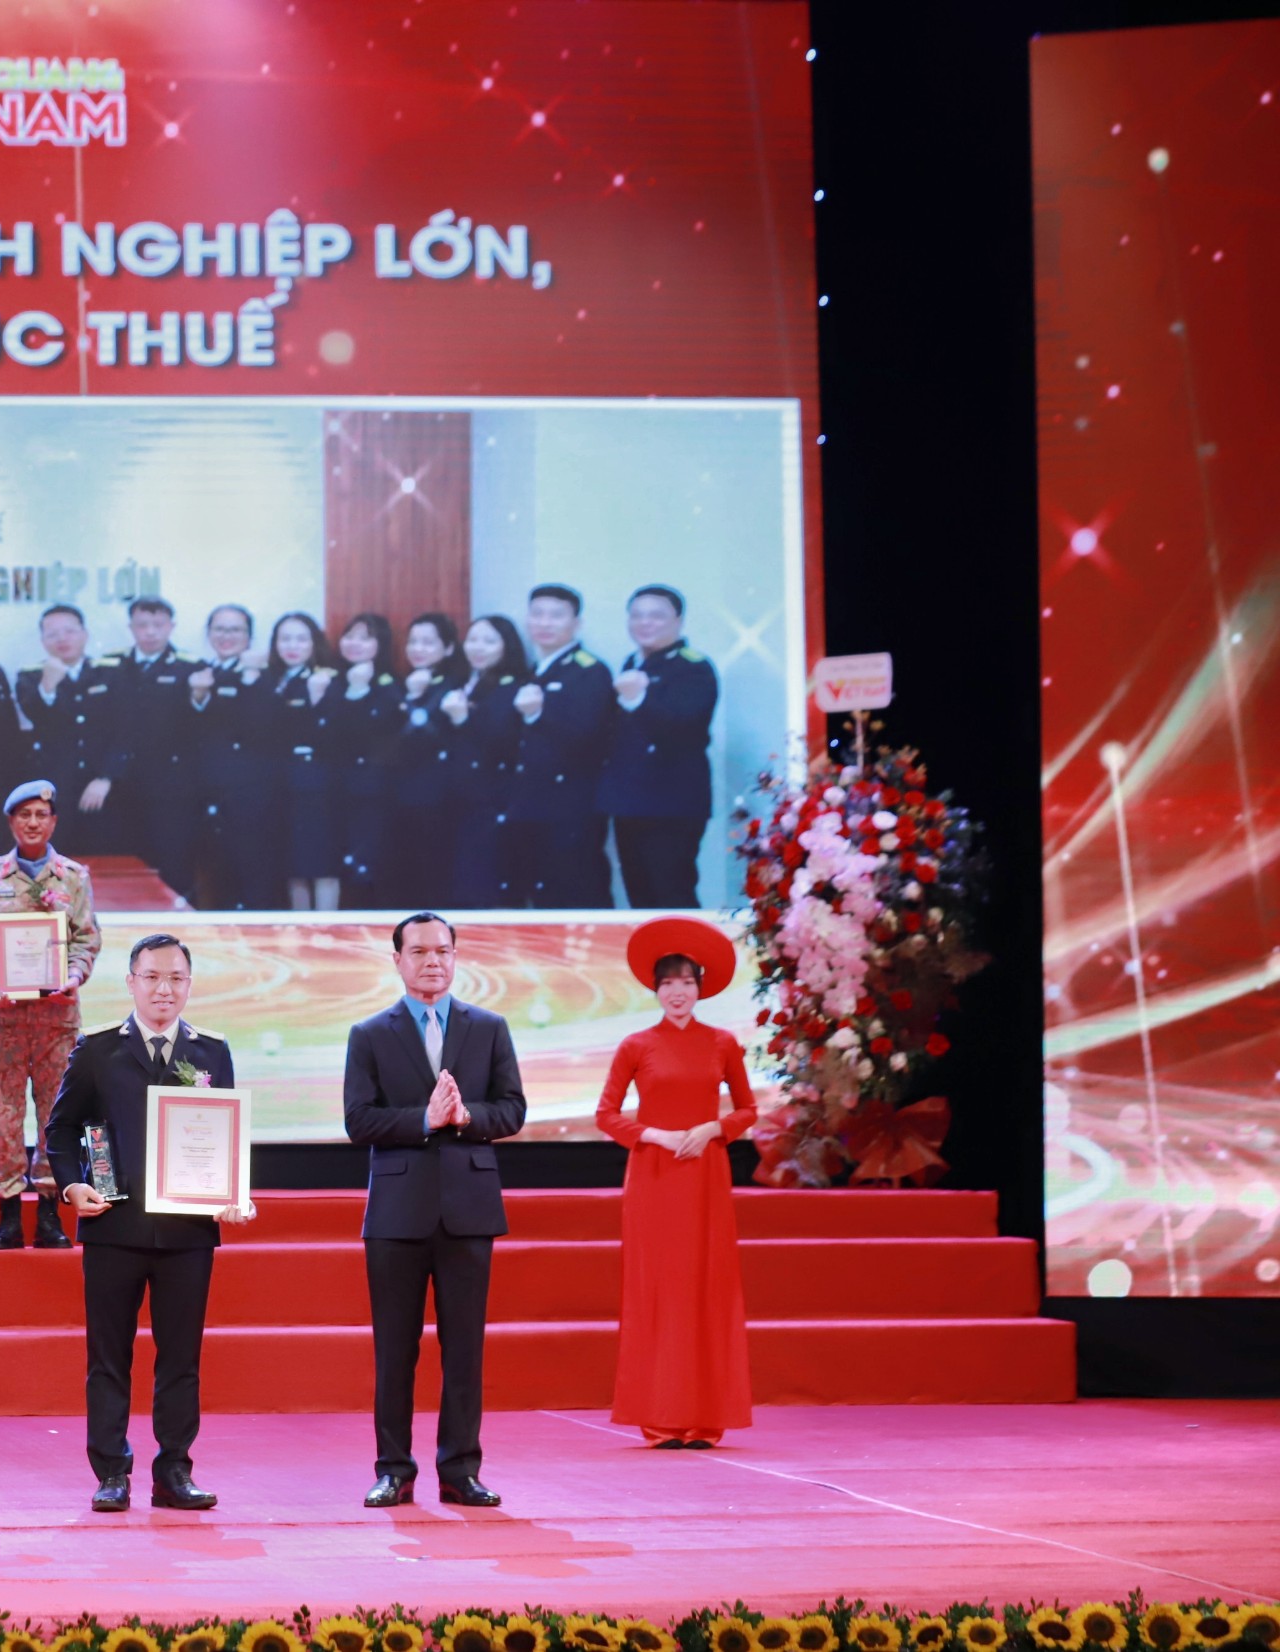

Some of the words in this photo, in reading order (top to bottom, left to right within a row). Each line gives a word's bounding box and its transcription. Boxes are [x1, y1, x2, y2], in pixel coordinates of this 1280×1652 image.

[61, 208, 352, 292] NGHIỆP
[374, 209, 552, 288] LỚN,
[86, 290, 290, 366] THUẾ
